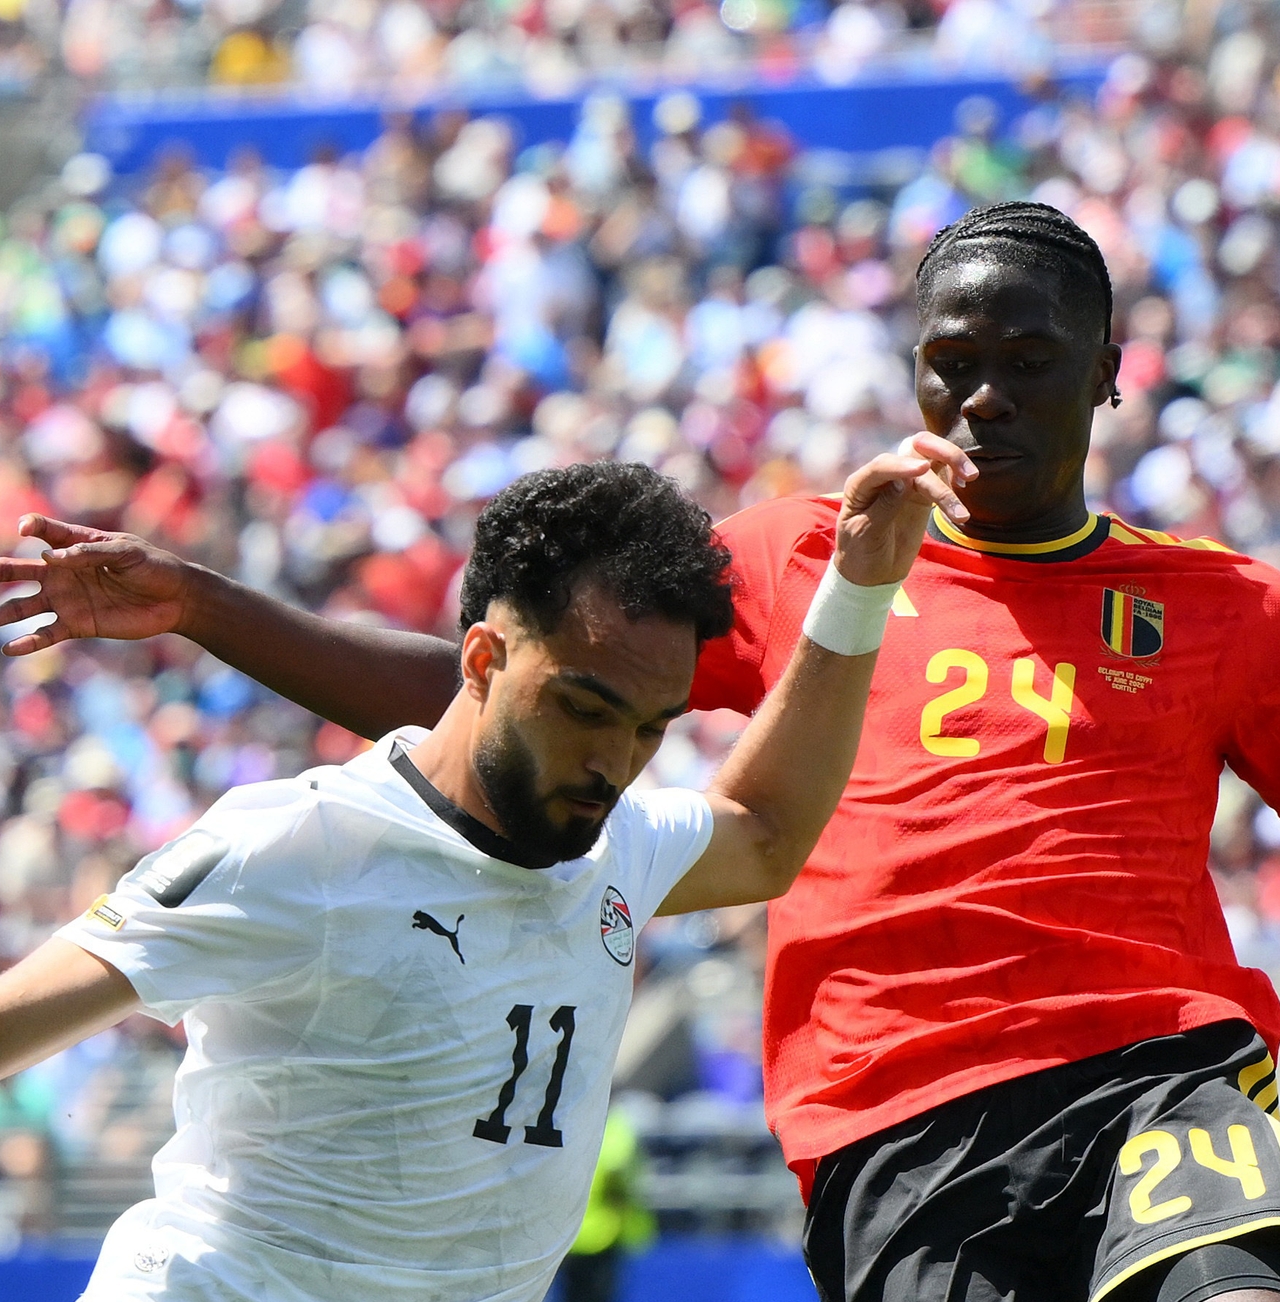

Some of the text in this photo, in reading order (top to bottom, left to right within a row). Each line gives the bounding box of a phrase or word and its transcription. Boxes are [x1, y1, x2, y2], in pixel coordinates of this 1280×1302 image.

[920, 648, 1076, 764] 24
[472, 1004, 577, 1148] 11
[1119, 1124, 1267, 1224] 24
